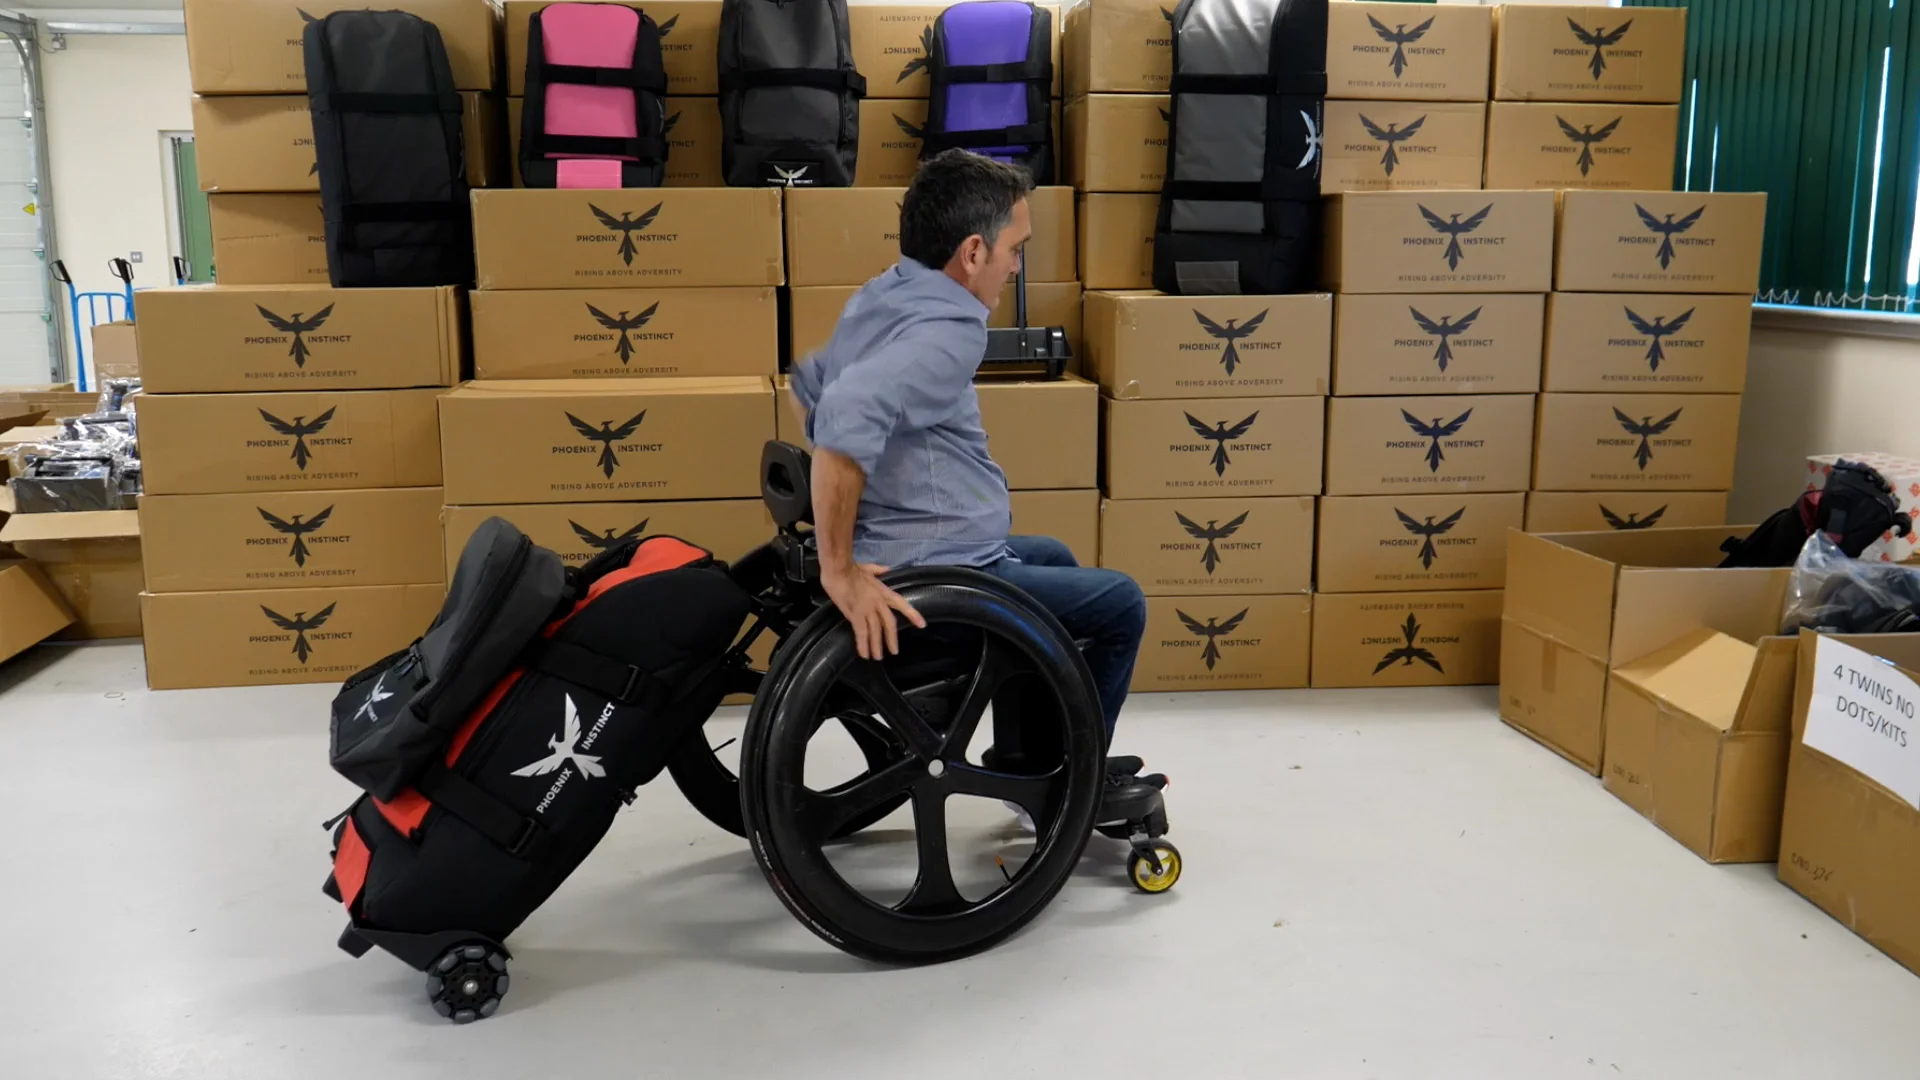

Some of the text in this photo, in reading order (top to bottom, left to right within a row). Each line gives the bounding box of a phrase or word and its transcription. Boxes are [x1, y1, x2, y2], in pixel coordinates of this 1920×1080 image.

[1146, 38, 1172, 46] PHOE
[1353, 45, 1390, 53] PHOENIX
[1553, 49, 1643, 58] PHOENIX INSTINCT
[881, 141, 917, 149] PHOENIX
[1144, 138, 1168, 146] PHOE
[1344, 144, 1438, 153] PHOENIX INSTINCT
[1541, 145, 1631, 155] PHOENIX INSTINCT
[1464, 237, 1505, 245] INSTINCT
[1618, 236, 1716, 246] PHOENIX INSTINCT
[244, 335, 352, 345] PHOENIX INSTINCT
[1394, 339, 1433, 347] PHOENIX
[1664, 340, 1705, 348] INSTINCT
[1179, 342, 1282, 351] PHOENIX INSTINCT
[310, 370, 358, 378] ADVERSITY
[246, 438, 352, 448] PHOENIX INSTINCT
[1386, 440, 1484, 449] PHOENIX INSTINCT
[1597, 438, 1692, 447] PHOENIX INSTINCT
[552, 444, 663, 454] PHOENIX INSTINCT
[1170, 443, 1272, 452] PHOENIX INSTINCT
[311, 472, 359, 480] ADVERSITY
[551, 483, 582, 491] RISING
[618, 480, 668, 488] ADVERSITY
[1220, 542, 1262, 550] INSTINCT
[1380, 538, 1477, 547] PHOENIX INSTINCT
[309, 569, 356, 577] ADVERSITY
[249, 632, 353, 643] PHOENIX INSTINCT
[1361, 636, 1460, 645] PHOENIX INSTINCT
[1834, 665, 1914, 719] 4 TWINS NO
[1836, 695, 1907, 747] DOTS/KITS
[536, 702, 615, 814] PHOENIX INSTINCT
